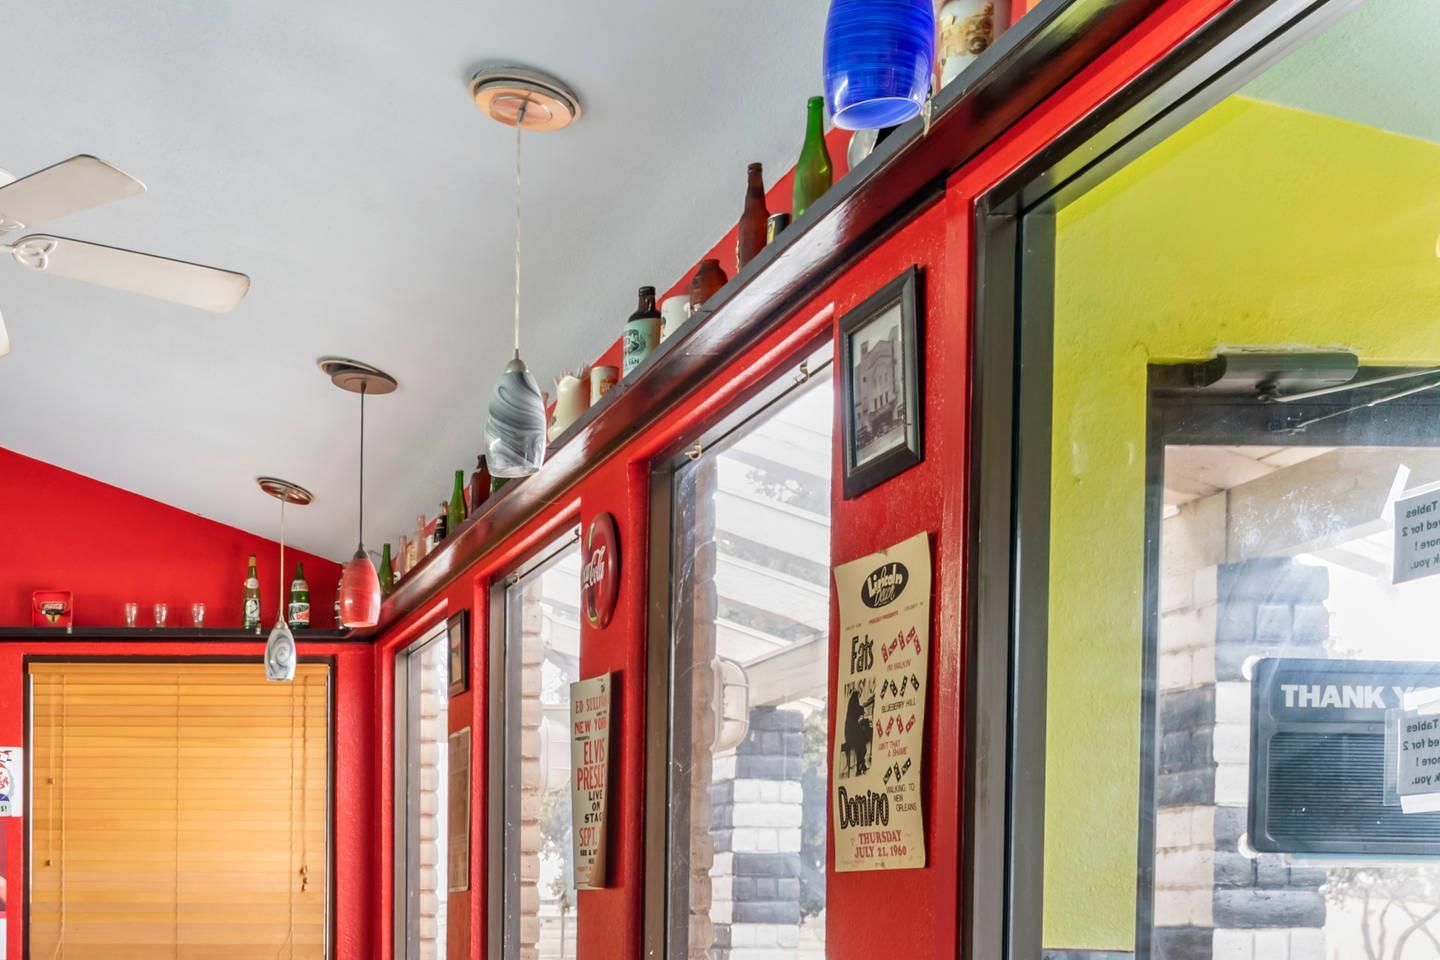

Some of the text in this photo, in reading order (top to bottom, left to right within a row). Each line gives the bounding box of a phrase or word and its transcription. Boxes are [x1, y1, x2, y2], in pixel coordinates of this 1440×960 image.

[867, 564, 903, 598] Lincoln
[850, 634, 874, 675] Fats
[1280, 684, 1386, 709] THANK
[575, 700, 584, 714] ED
[574, 719, 591, 735] NEW
[583, 739, 605, 766] ELVIS
[577, 764, 605, 790] PRESL
[588, 789, 603, 801] LIVE
[838, 785, 889, 830] Domino
[584, 812, 602, 824] STAG
[858, 829, 902, 845] THURSDAY
[854, 846, 874, 859] JULY
[890, 844, 907, 857] 1960
